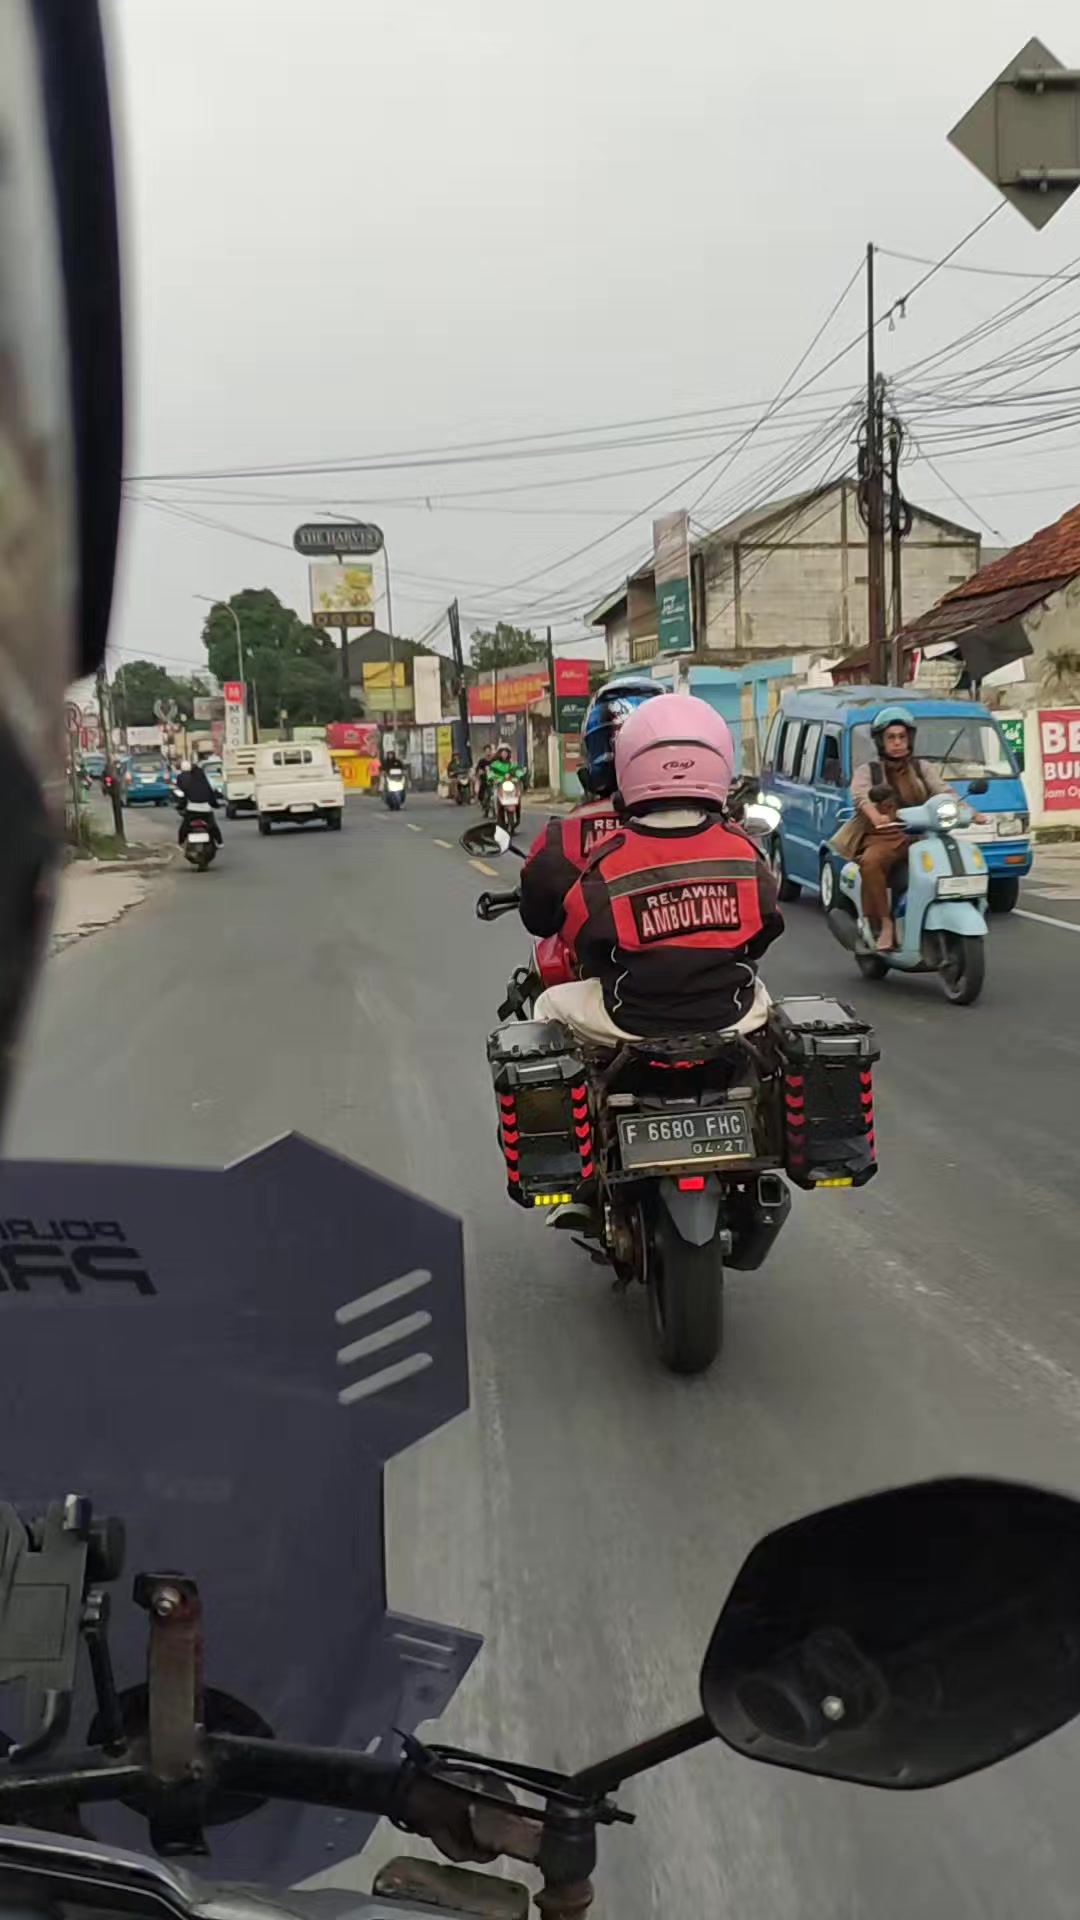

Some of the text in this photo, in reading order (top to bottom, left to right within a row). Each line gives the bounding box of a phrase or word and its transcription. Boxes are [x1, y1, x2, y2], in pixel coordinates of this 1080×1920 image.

[646, 885, 727, 908] RELAWAN
[642, 898, 738, 937] AMBULANCE
[626, 1115, 741, 1144] F 6680 FHG
